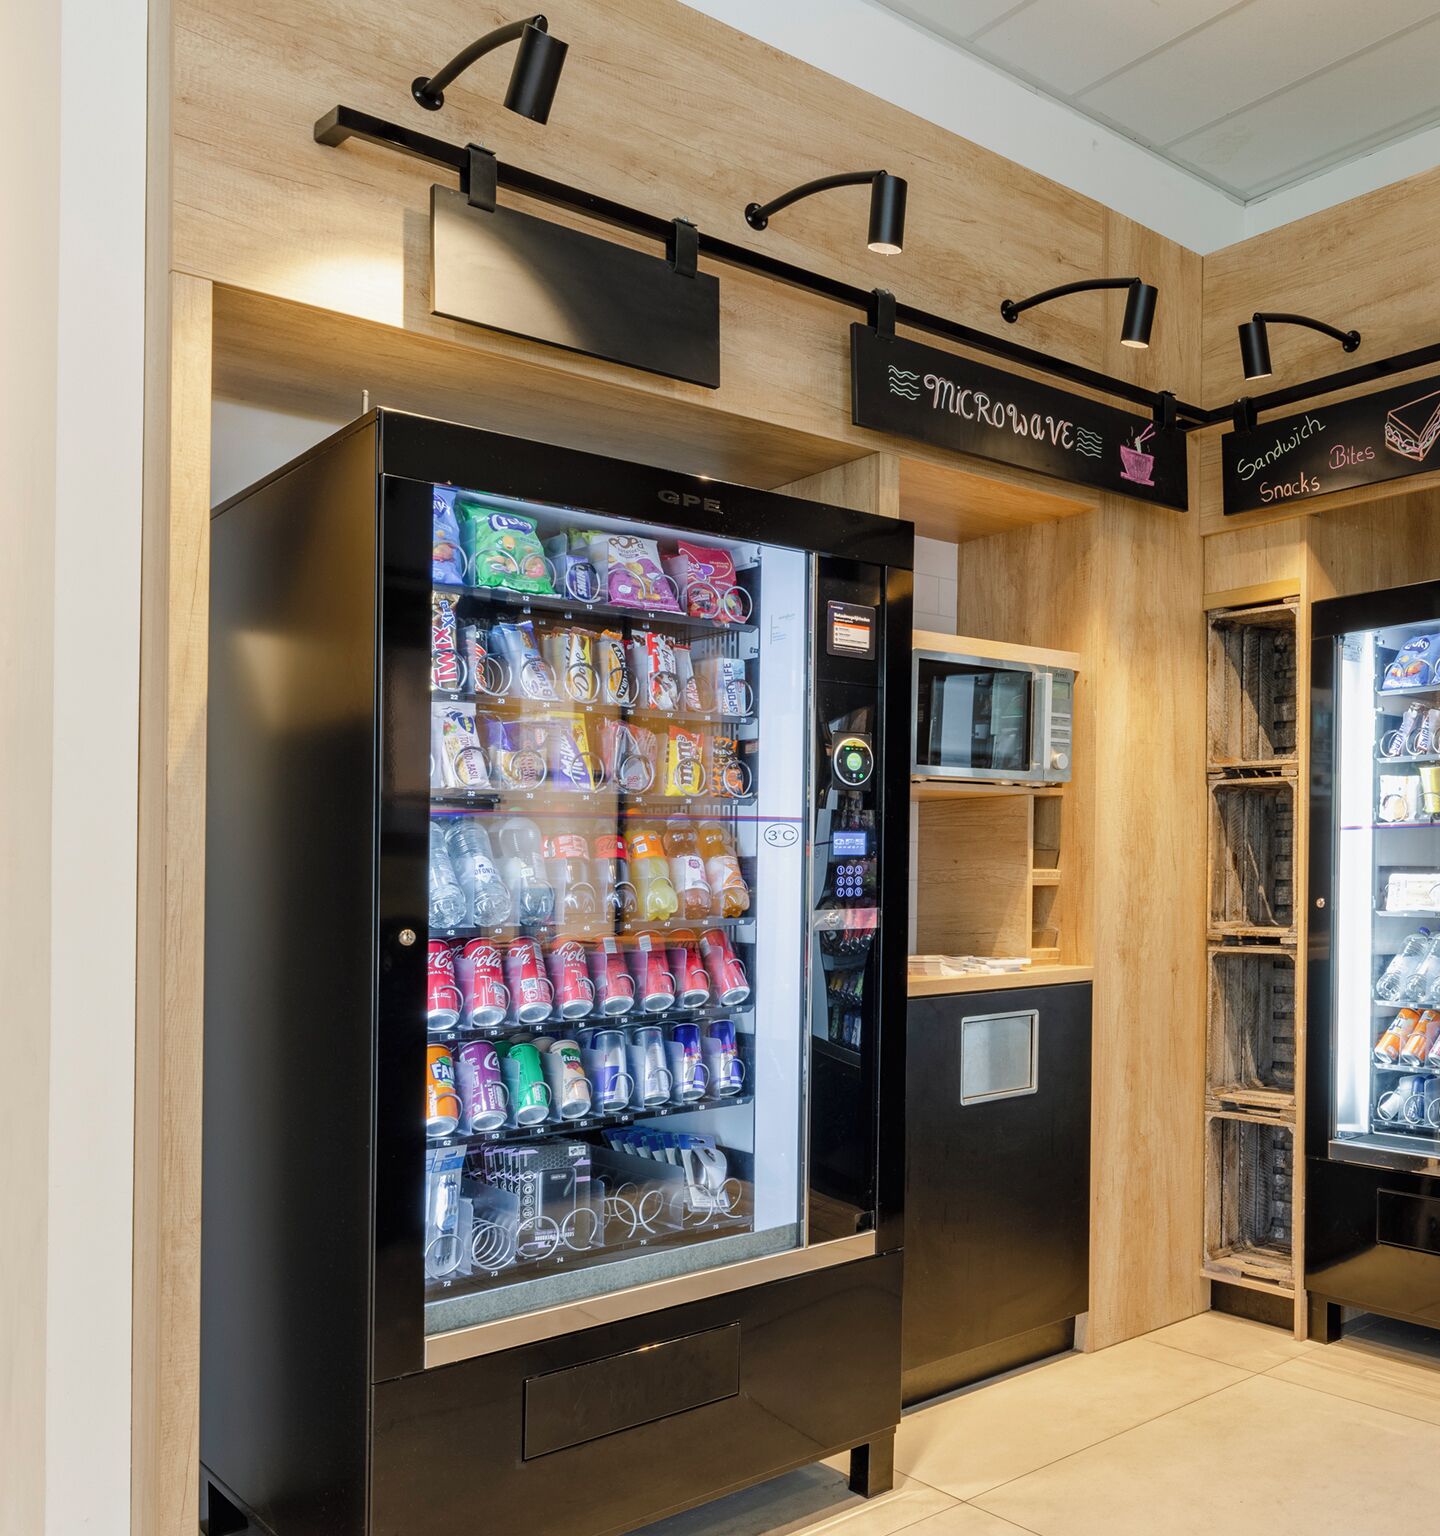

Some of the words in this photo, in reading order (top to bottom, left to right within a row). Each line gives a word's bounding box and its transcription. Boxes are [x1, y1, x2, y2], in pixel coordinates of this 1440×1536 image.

[1237, 415, 1326, 481] Sandwich
[1328, 444, 1376, 470] Bites
[657, 490, 723, 515] GPE
[1259, 471, 1321, 503] Snacks
[433, 627, 457, 688] TWIX
[573, 653, 590, 697] Dove
